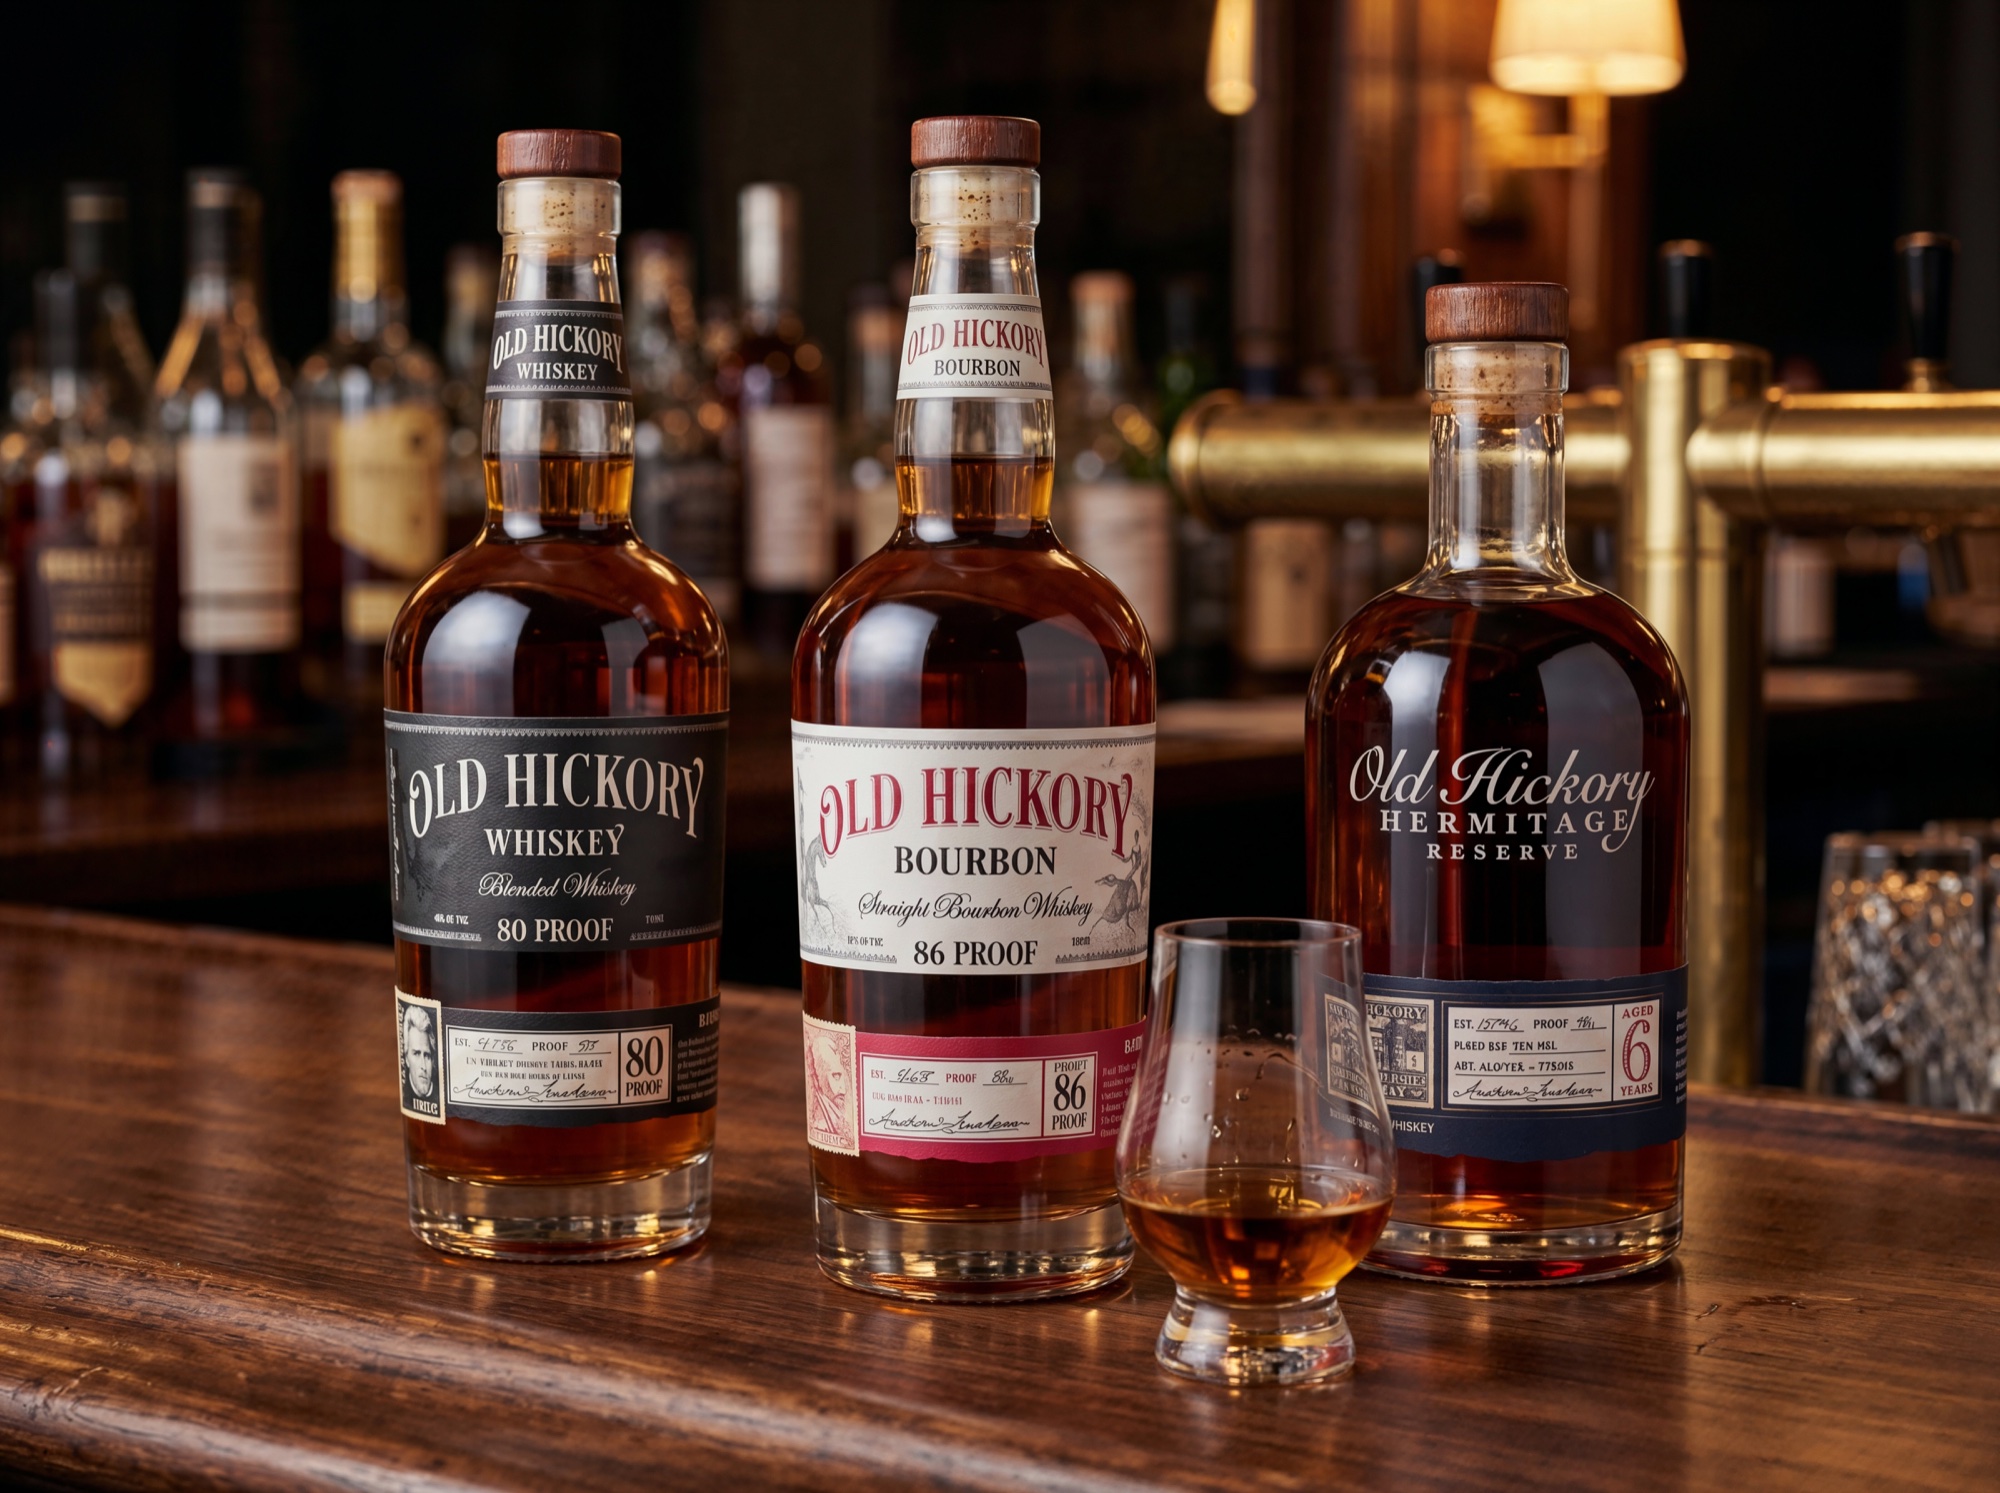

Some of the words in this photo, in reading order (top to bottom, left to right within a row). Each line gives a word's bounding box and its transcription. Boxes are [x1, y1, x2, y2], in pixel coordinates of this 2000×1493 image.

[493, 328, 527, 370] OLD
[533, 324, 623, 374] HICKORY
[908, 323, 945, 365] OLD
[953, 319, 1044, 368] HICKORY
[517, 362, 598, 380] WHISKEY
[934, 359, 1020, 376] BOURBON
[409, 758, 487, 838] OLD
[504, 753, 704, 838] HICKORY
[1350, 745, 1440, 802] Old
[1440, 746, 1655, 853] Hickory
[819, 773, 904, 858] OLD
[921, 766, 1133, 858] HICKORY
[1380, 809, 1629, 834] HERMITAGE
[484, 824, 625, 856] WHISKEY
[1427, 843, 1578, 860] RESERVE
[894, 846, 1057, 875] BOURBON
[478, 871, 560, 897] Blended
[563, 868, 637, 906] Whiskey
[858, 890, 930, 927] Straight
[933, 892, 1021, 919] Bourbon
[1023, 886, 1093, 926] Whiskey
[497, 919, 527, 942] 80
[534, 918, 613, 942] PROOF
[914, 940, 945, 966] 86
[953, 940, 1038, 966] PROOF
[1454, 1019, 1474, 1029] EST.
[1533, 1018, 1568, 1029] PROOF
[1622, 1005, 1653, 1019] AGED
[455, 1037, 470, 1048] EST.
[532, 1041, 568, 1051] PROOF
[625, 1035, 664, 1078] 80
[1622, 1019, 1651, 1082] 6
[625, 1078, 663, 1097] PROOF
[870, 1069, 886, 1080] EST.
[945, 1073, 977, 1083] PROOF
[1621, 1082, 1653, 1096] YEARS
[1053, 1071, 1086, 1111] 86
[1051, 1112, 1087, 1130] PROOF
